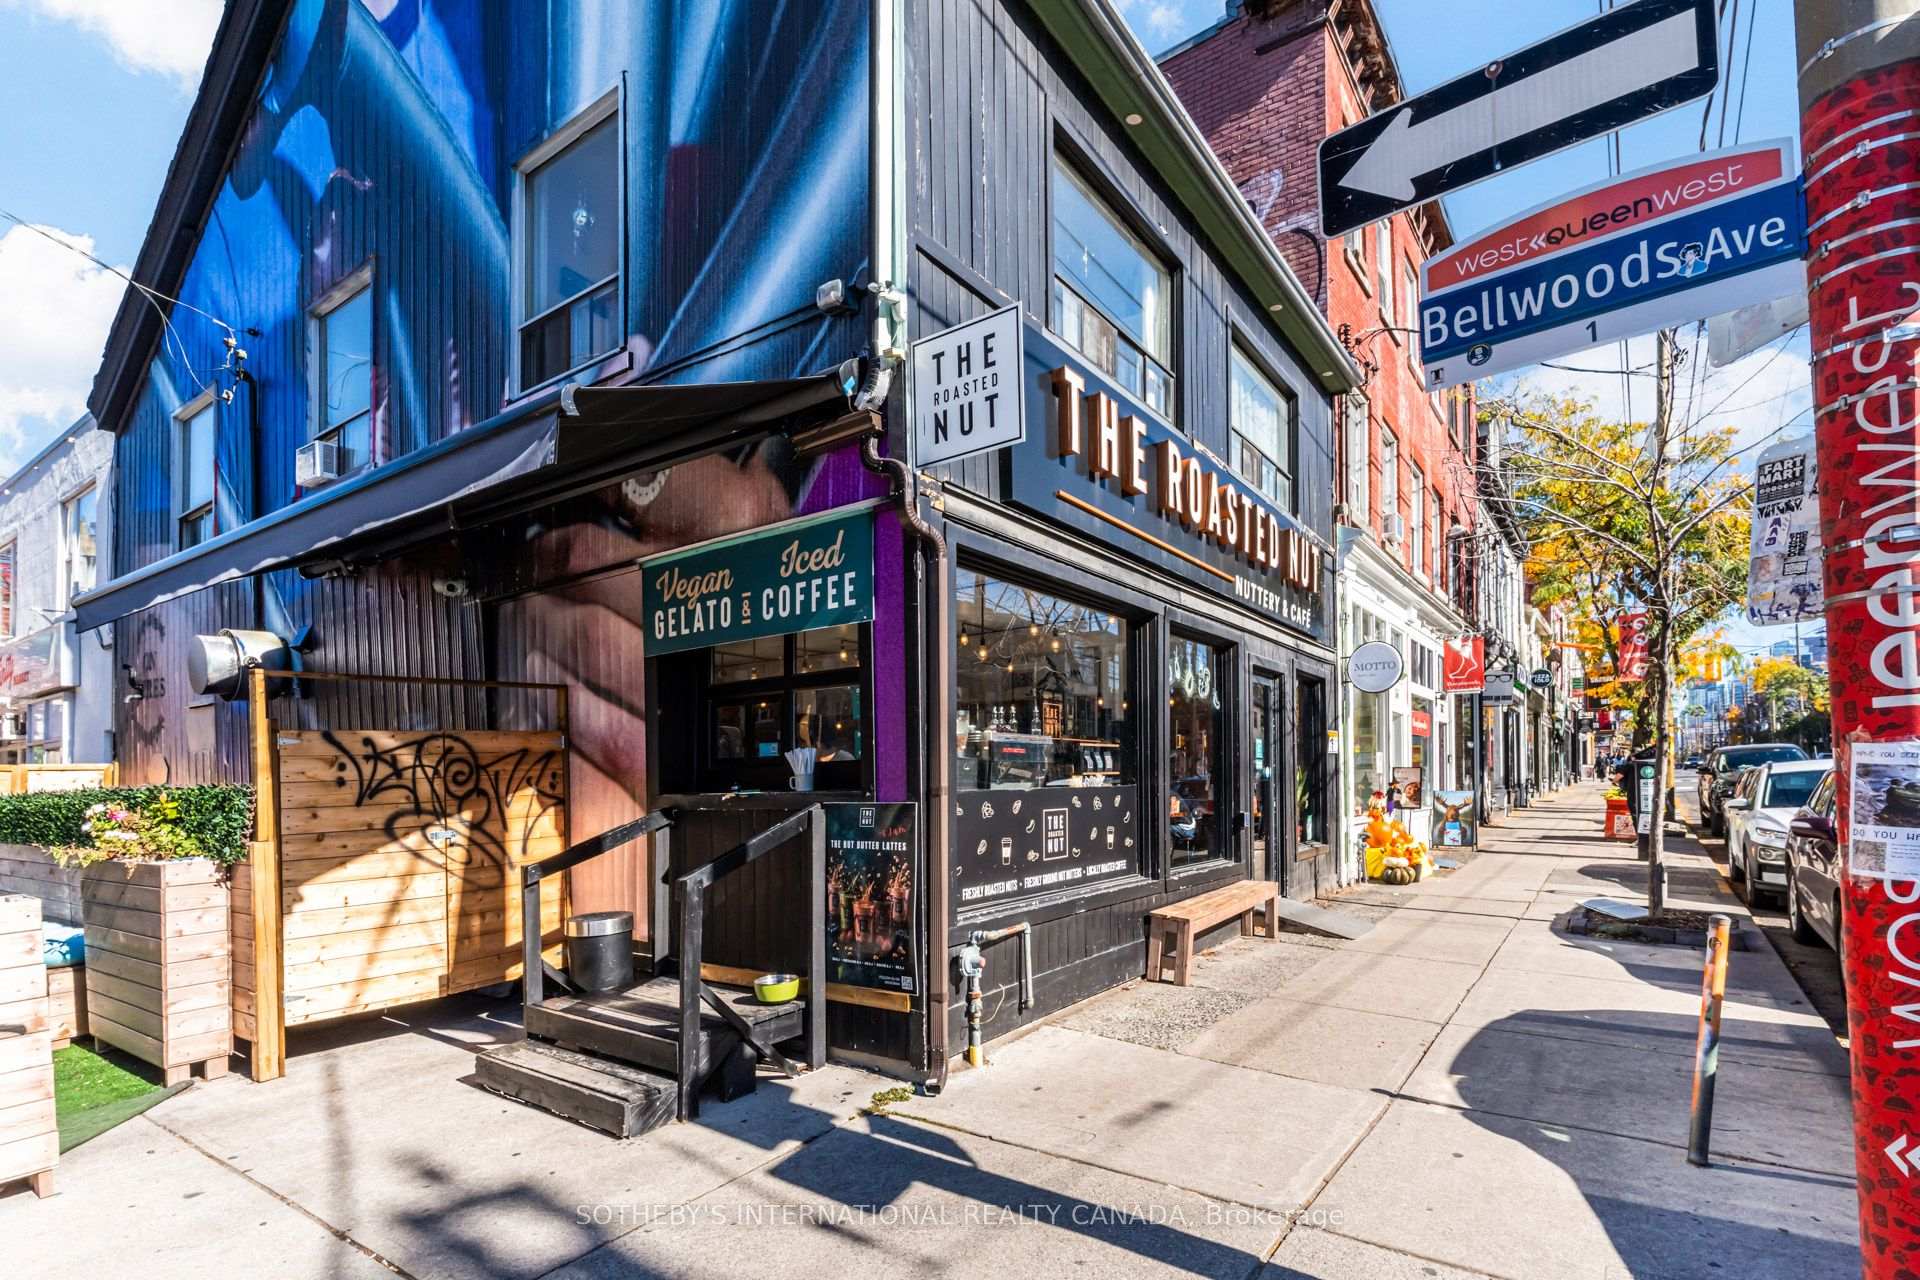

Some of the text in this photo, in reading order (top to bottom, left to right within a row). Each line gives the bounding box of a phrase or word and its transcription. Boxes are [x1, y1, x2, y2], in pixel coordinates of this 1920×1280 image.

[1423, 216, 1786, 348] Bellwoods Ave
[1585, 320, 1599, 343] 1
[931, 332, 997, 387] THE
[933, 372, 999, 407] ROASTED
[933, 393, 999, 445] NUT
[1052, 365, 1321, 594] THE ROASTED NUT
[1759, 466, 1803, 485] MART
[1764, 457, 1803, 475] FART
[780, 529, 846, 578] Iced
[656, 567, 734, 609] Vegan
[1235, 575, 1311, 629] NUTTERY & CAFÉ
[654, 597, 732, 640] GELATO
[762, 571, 857, 621] COFFEE
[1354, 661, 1397, 672] MOTTO
[1047, 815, 1064, 830] THE
[1852, 828, 1865, 837] DO
[1873, 830, 1897, 840] YOU
[831, 839, 842, 849] THE
[843, 840, 855, 849] NUT
[881, 841, 907, 851] LATTES
[1047, 837, 1064, 854] NUT
[962, 885, 984, 902] FRESHLY
[984, 881, 1006, 897] ROASTED
[1005, 879, 1018, 893] NUTS
[1024, 874, 1042, 889] FRESHLY
